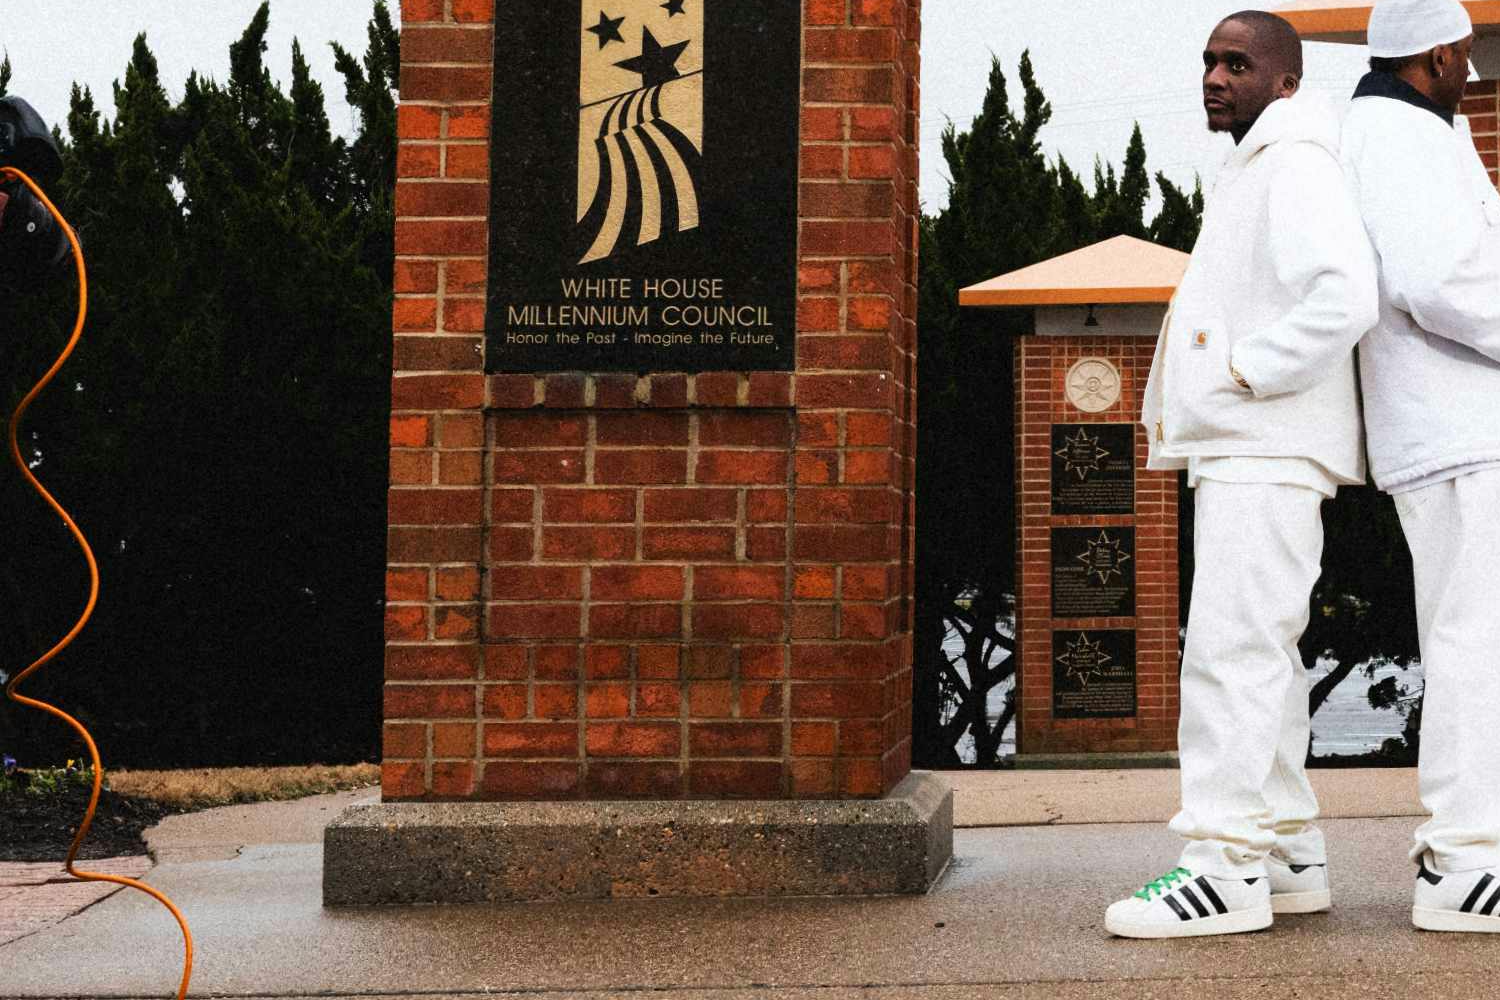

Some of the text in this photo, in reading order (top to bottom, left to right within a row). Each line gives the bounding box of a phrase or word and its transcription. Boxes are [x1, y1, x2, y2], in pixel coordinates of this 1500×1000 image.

[561, 278, 724, 299] WHITE HOUSE
[508, 305, 773, 326] MILLENNIUM COUNCIL
[506, 332, 548, 344] Honor
[557, 331, 580, 344] the
[586, 331, 616, 344] Past
[634, 331, 693, 347] Imagine
[700, 331, 724, 344] the
[730, 331, 774, 344] Future
